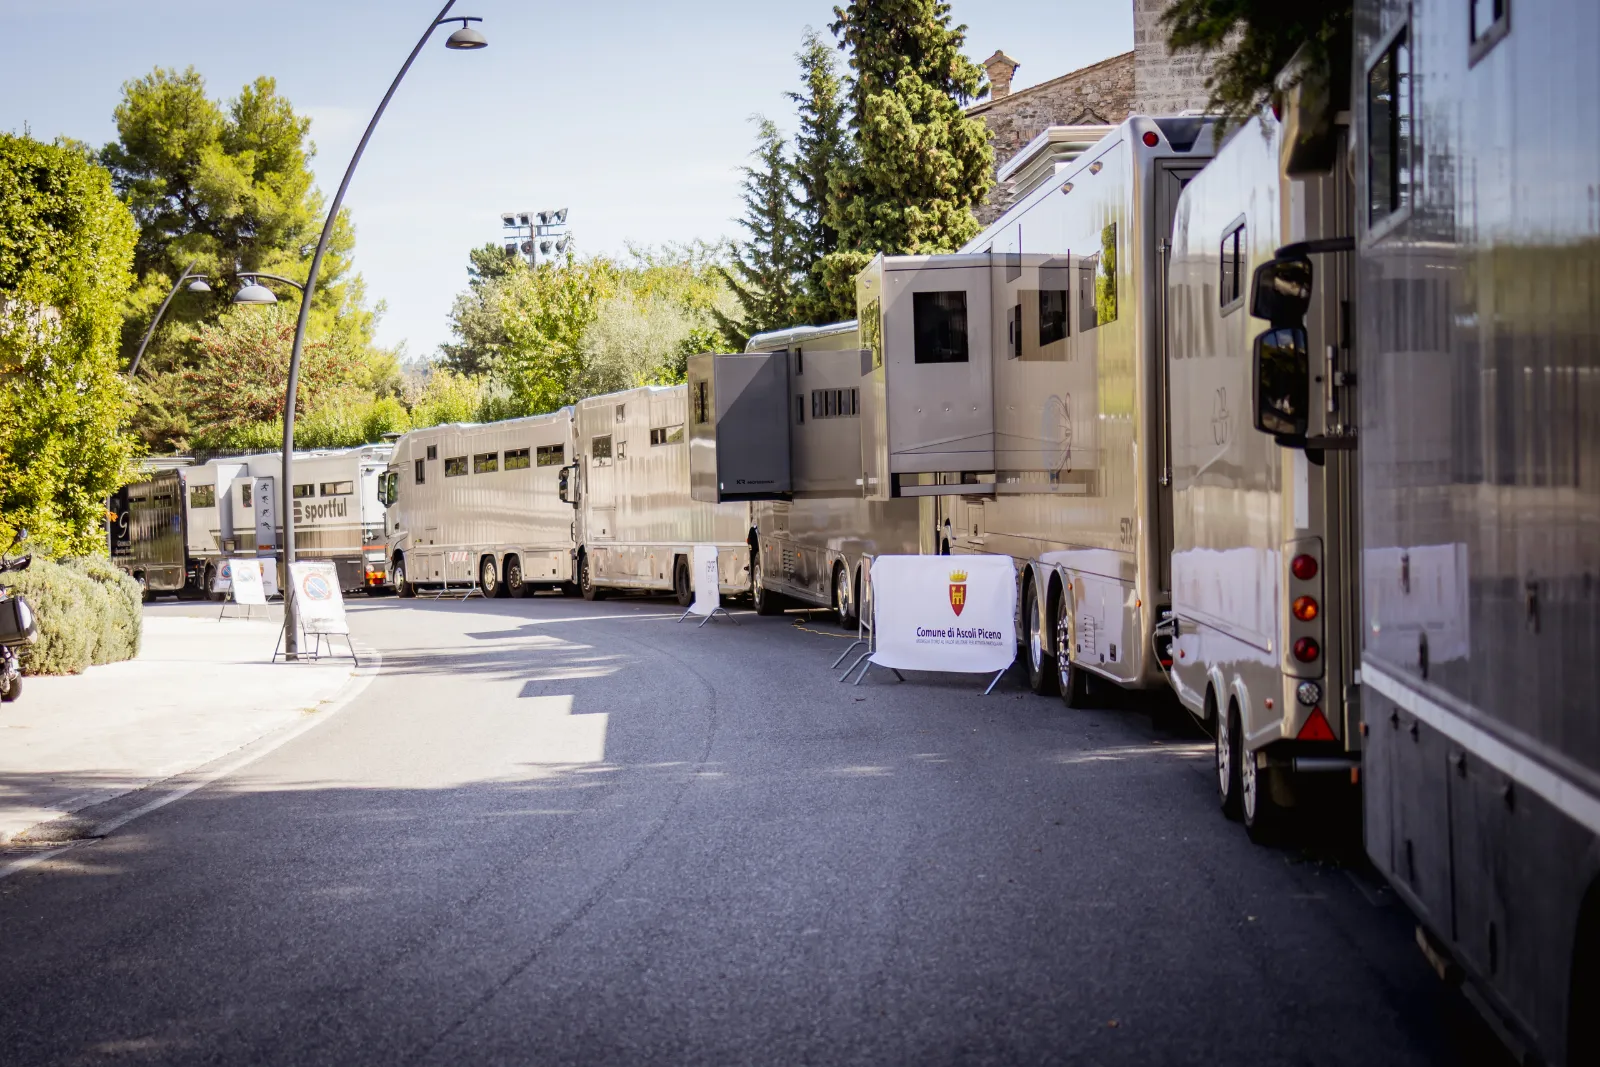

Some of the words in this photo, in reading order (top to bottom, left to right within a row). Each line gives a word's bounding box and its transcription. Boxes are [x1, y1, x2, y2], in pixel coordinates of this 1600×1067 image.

[305, 497, 347, 523] sportful
[916, 626, 946, 638] Comune
[947, 627, 955, 638] di
[956, 627, 977, 639] Ascoli
[978, 628, 1002, 640] Piceno
